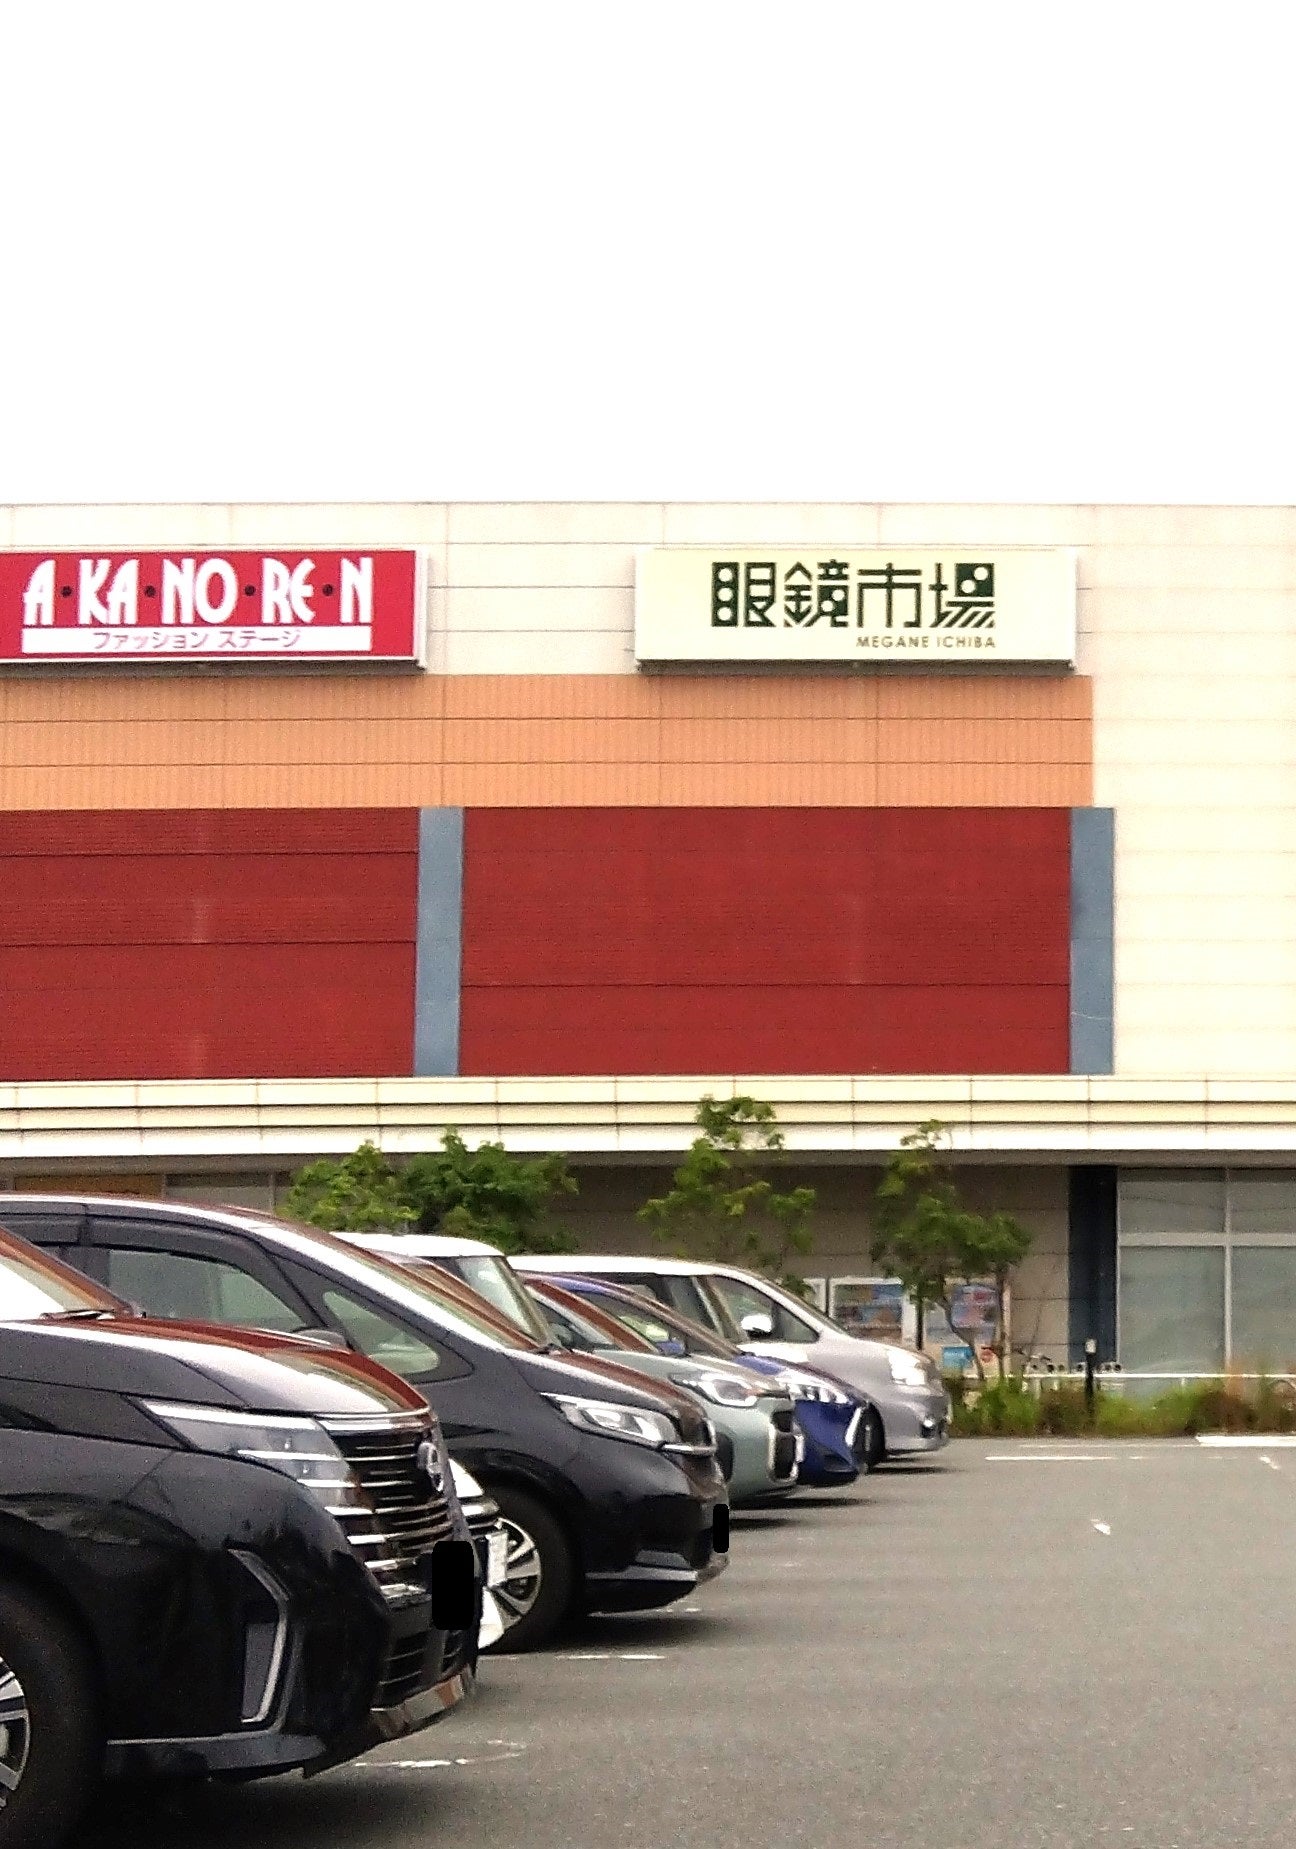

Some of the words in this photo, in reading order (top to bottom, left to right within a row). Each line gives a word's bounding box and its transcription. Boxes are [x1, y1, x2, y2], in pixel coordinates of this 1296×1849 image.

[711, 559, 996, 628] 眼鏡市場
[93, 630, 208, 650] ファッション
[218, 629, 301, 649] ステージ
[856, 635, 929, 648] MEGANE
[936, 635, 996, 648] ICHIBA
